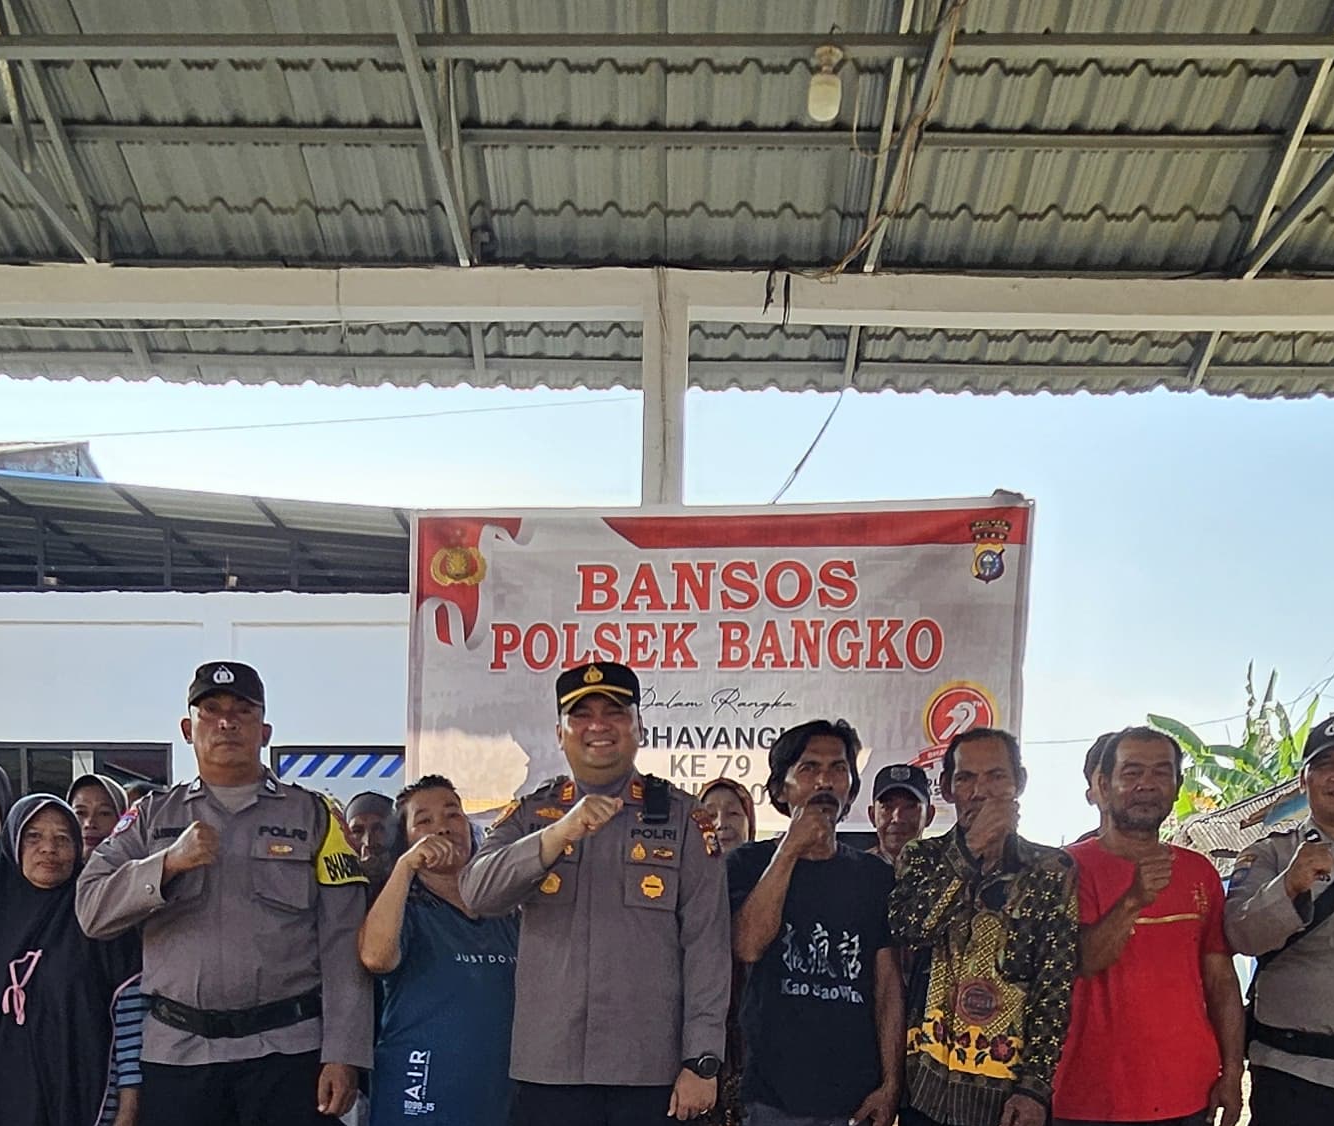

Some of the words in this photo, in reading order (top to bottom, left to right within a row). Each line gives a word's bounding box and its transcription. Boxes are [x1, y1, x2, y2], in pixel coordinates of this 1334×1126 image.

[576, 560, 858, 612] BANSOS
[490, 621, 698, 670] POLSEK
[718, 618, 944, 670] BANGKO
[640, 686, 702, 711] Dalam
[711, 687, 796, 718] Rangka
[639, 726, 784, 750] BHAYANG
[670, 754, 706, 778] KE
[716, 754, 751, 778] 79
[259, 826, 308, 841] POLRI
[631, 828, 677, 841] POLRI
[455, 952, 484, 963] JUST
[488, 954, 506, 963] DO
